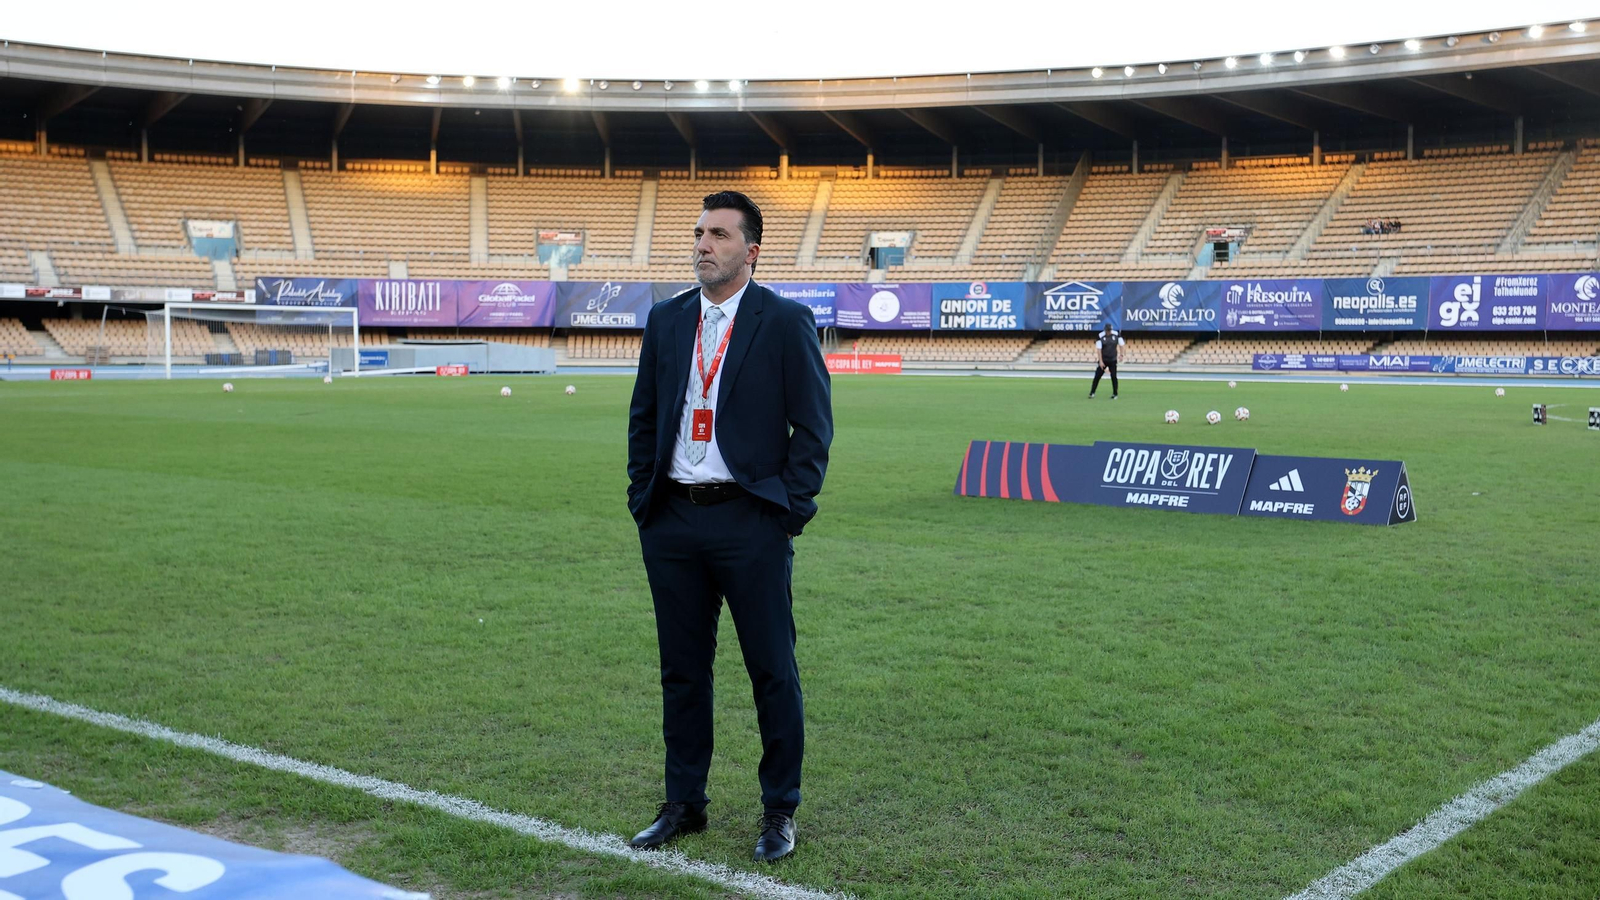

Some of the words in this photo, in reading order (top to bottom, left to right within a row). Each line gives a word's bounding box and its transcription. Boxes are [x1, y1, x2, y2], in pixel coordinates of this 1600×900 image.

[1495, 276, 1538, 286] #FromXerez
[779, 289, 836, 298] Inmobiliaria
[1247, 283, 1262, 294] LA
[1494, 286, 1538, 296] ToTheMundo
[375, 281, 440, 311] KIRIBATI
[478, 294, 536, 302] GlobalPadel
[1046, 295, 1100, 310] MdR
[940, 300, 988, 313] UNION
[992, 300, 1012, 313] DE
[1334, 294, 1417, 314] neopolis.es
[574, 314, 634, 324] JMELECTRI
[940, 314, 1016, 329] LIMPIEZAS
[1126, 308, 1216, 322] MONTEALTO
[1369, 356, 1404, 366] MIA
[1457, 358, 1524, 368] JMELECTRI
[1102, 448, 1158, 485] COPA
[1186, 451, 1233, 490] REY
[1126, 492, 1189, 507] MAPFRE
[1249, 500, 1314, 514] MAPFRE
